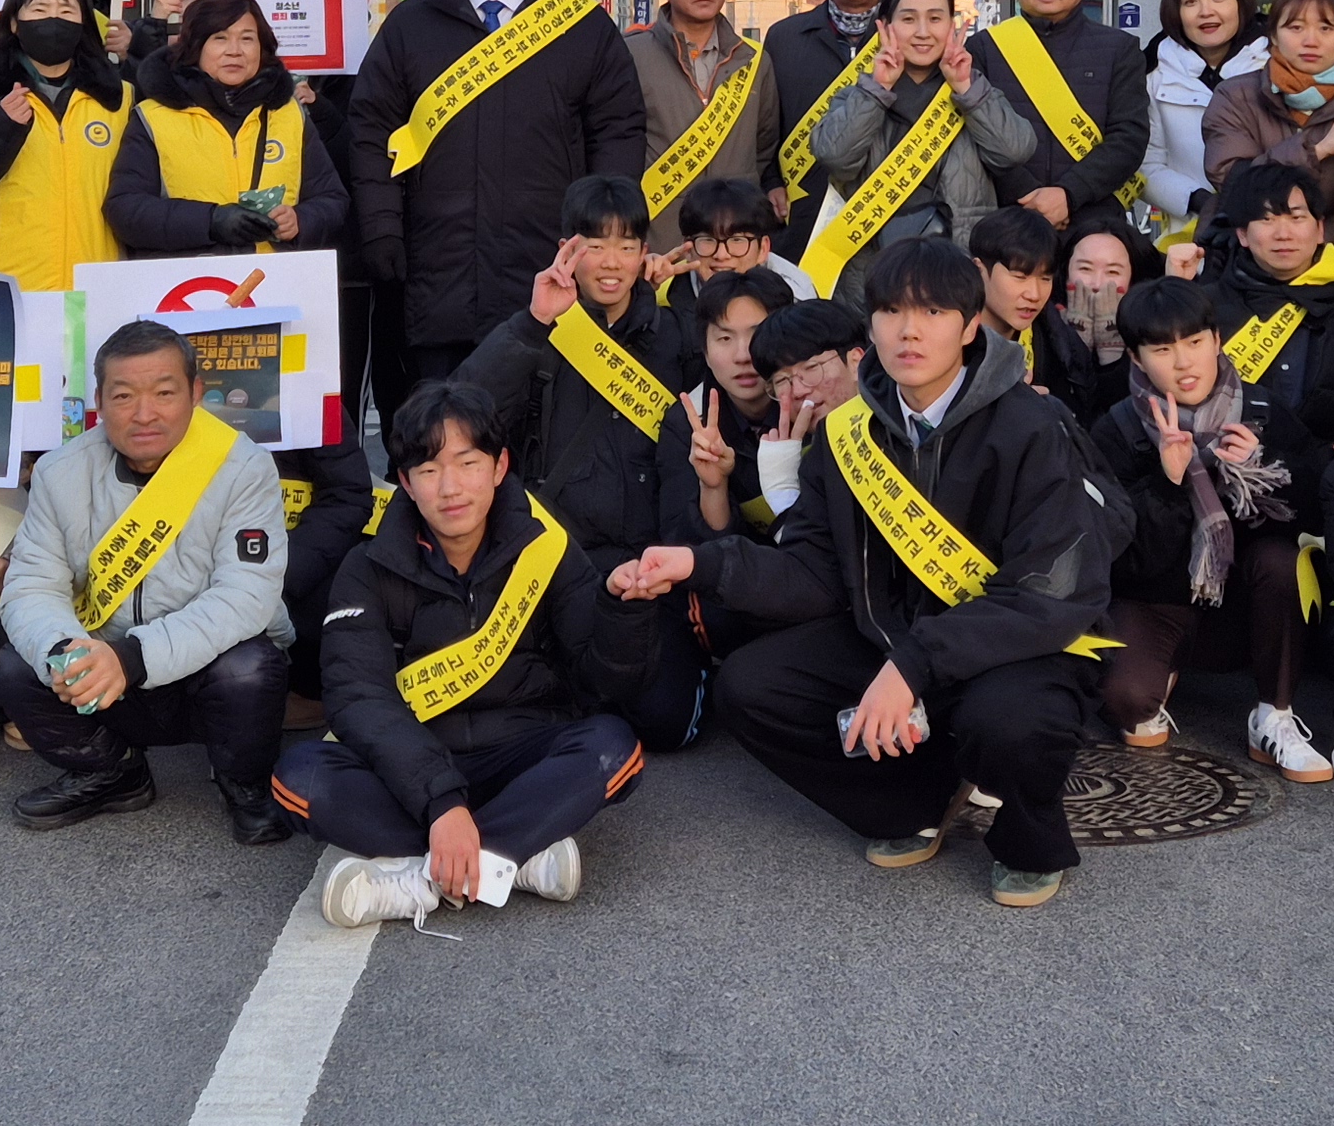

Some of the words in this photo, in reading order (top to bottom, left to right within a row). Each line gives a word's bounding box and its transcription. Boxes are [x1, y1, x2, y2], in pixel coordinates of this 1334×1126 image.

[1125, 15, 1133, 26] 4
[202, 359, 213, 371] 수
[247, 538, 261, 555] G
